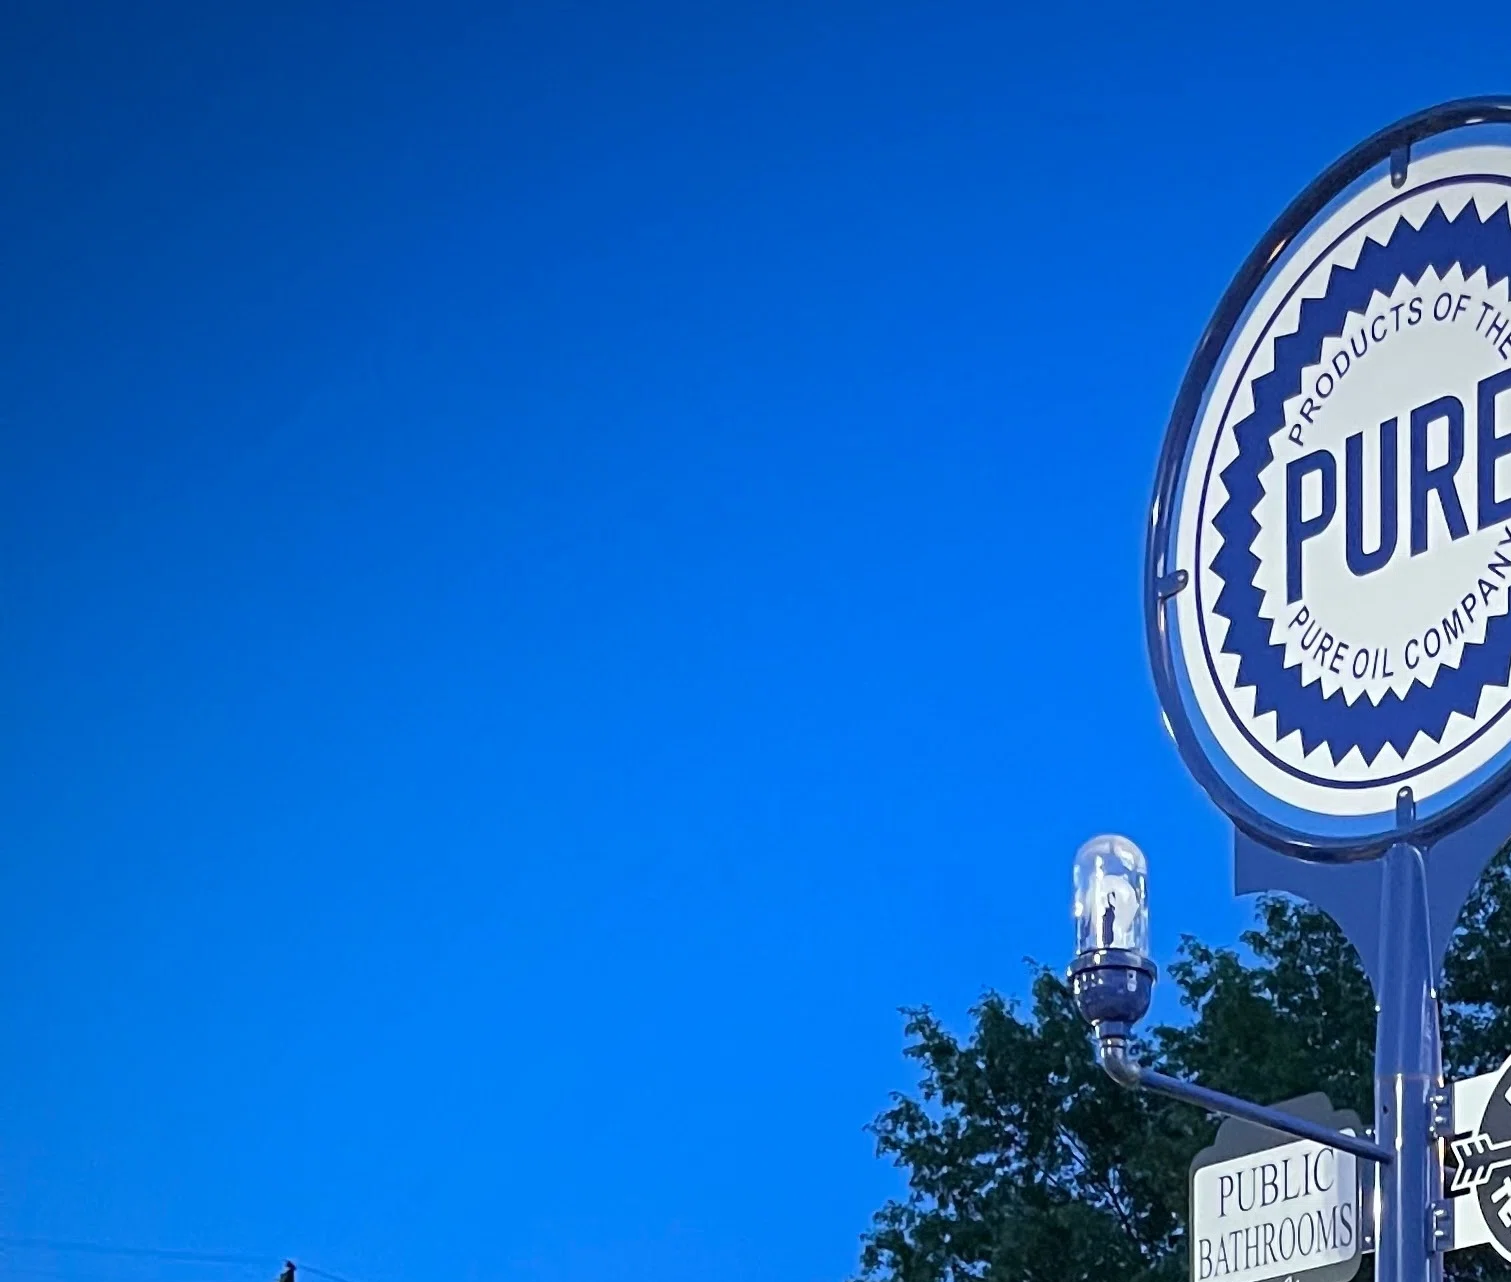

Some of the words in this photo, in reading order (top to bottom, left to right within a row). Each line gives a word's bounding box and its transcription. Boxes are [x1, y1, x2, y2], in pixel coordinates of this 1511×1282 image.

[1288, 296, 1423, 447] PRODUCTS
[1433, 292, 1471, 322] OF
[1288, 605, 1349, 674] PURE
[1352, 648, 1394, 679] OIL
[1218, 1147, 1335, 1218] PUBLIC
[1199, 1203, 1353, 1280] BATHROOMS
